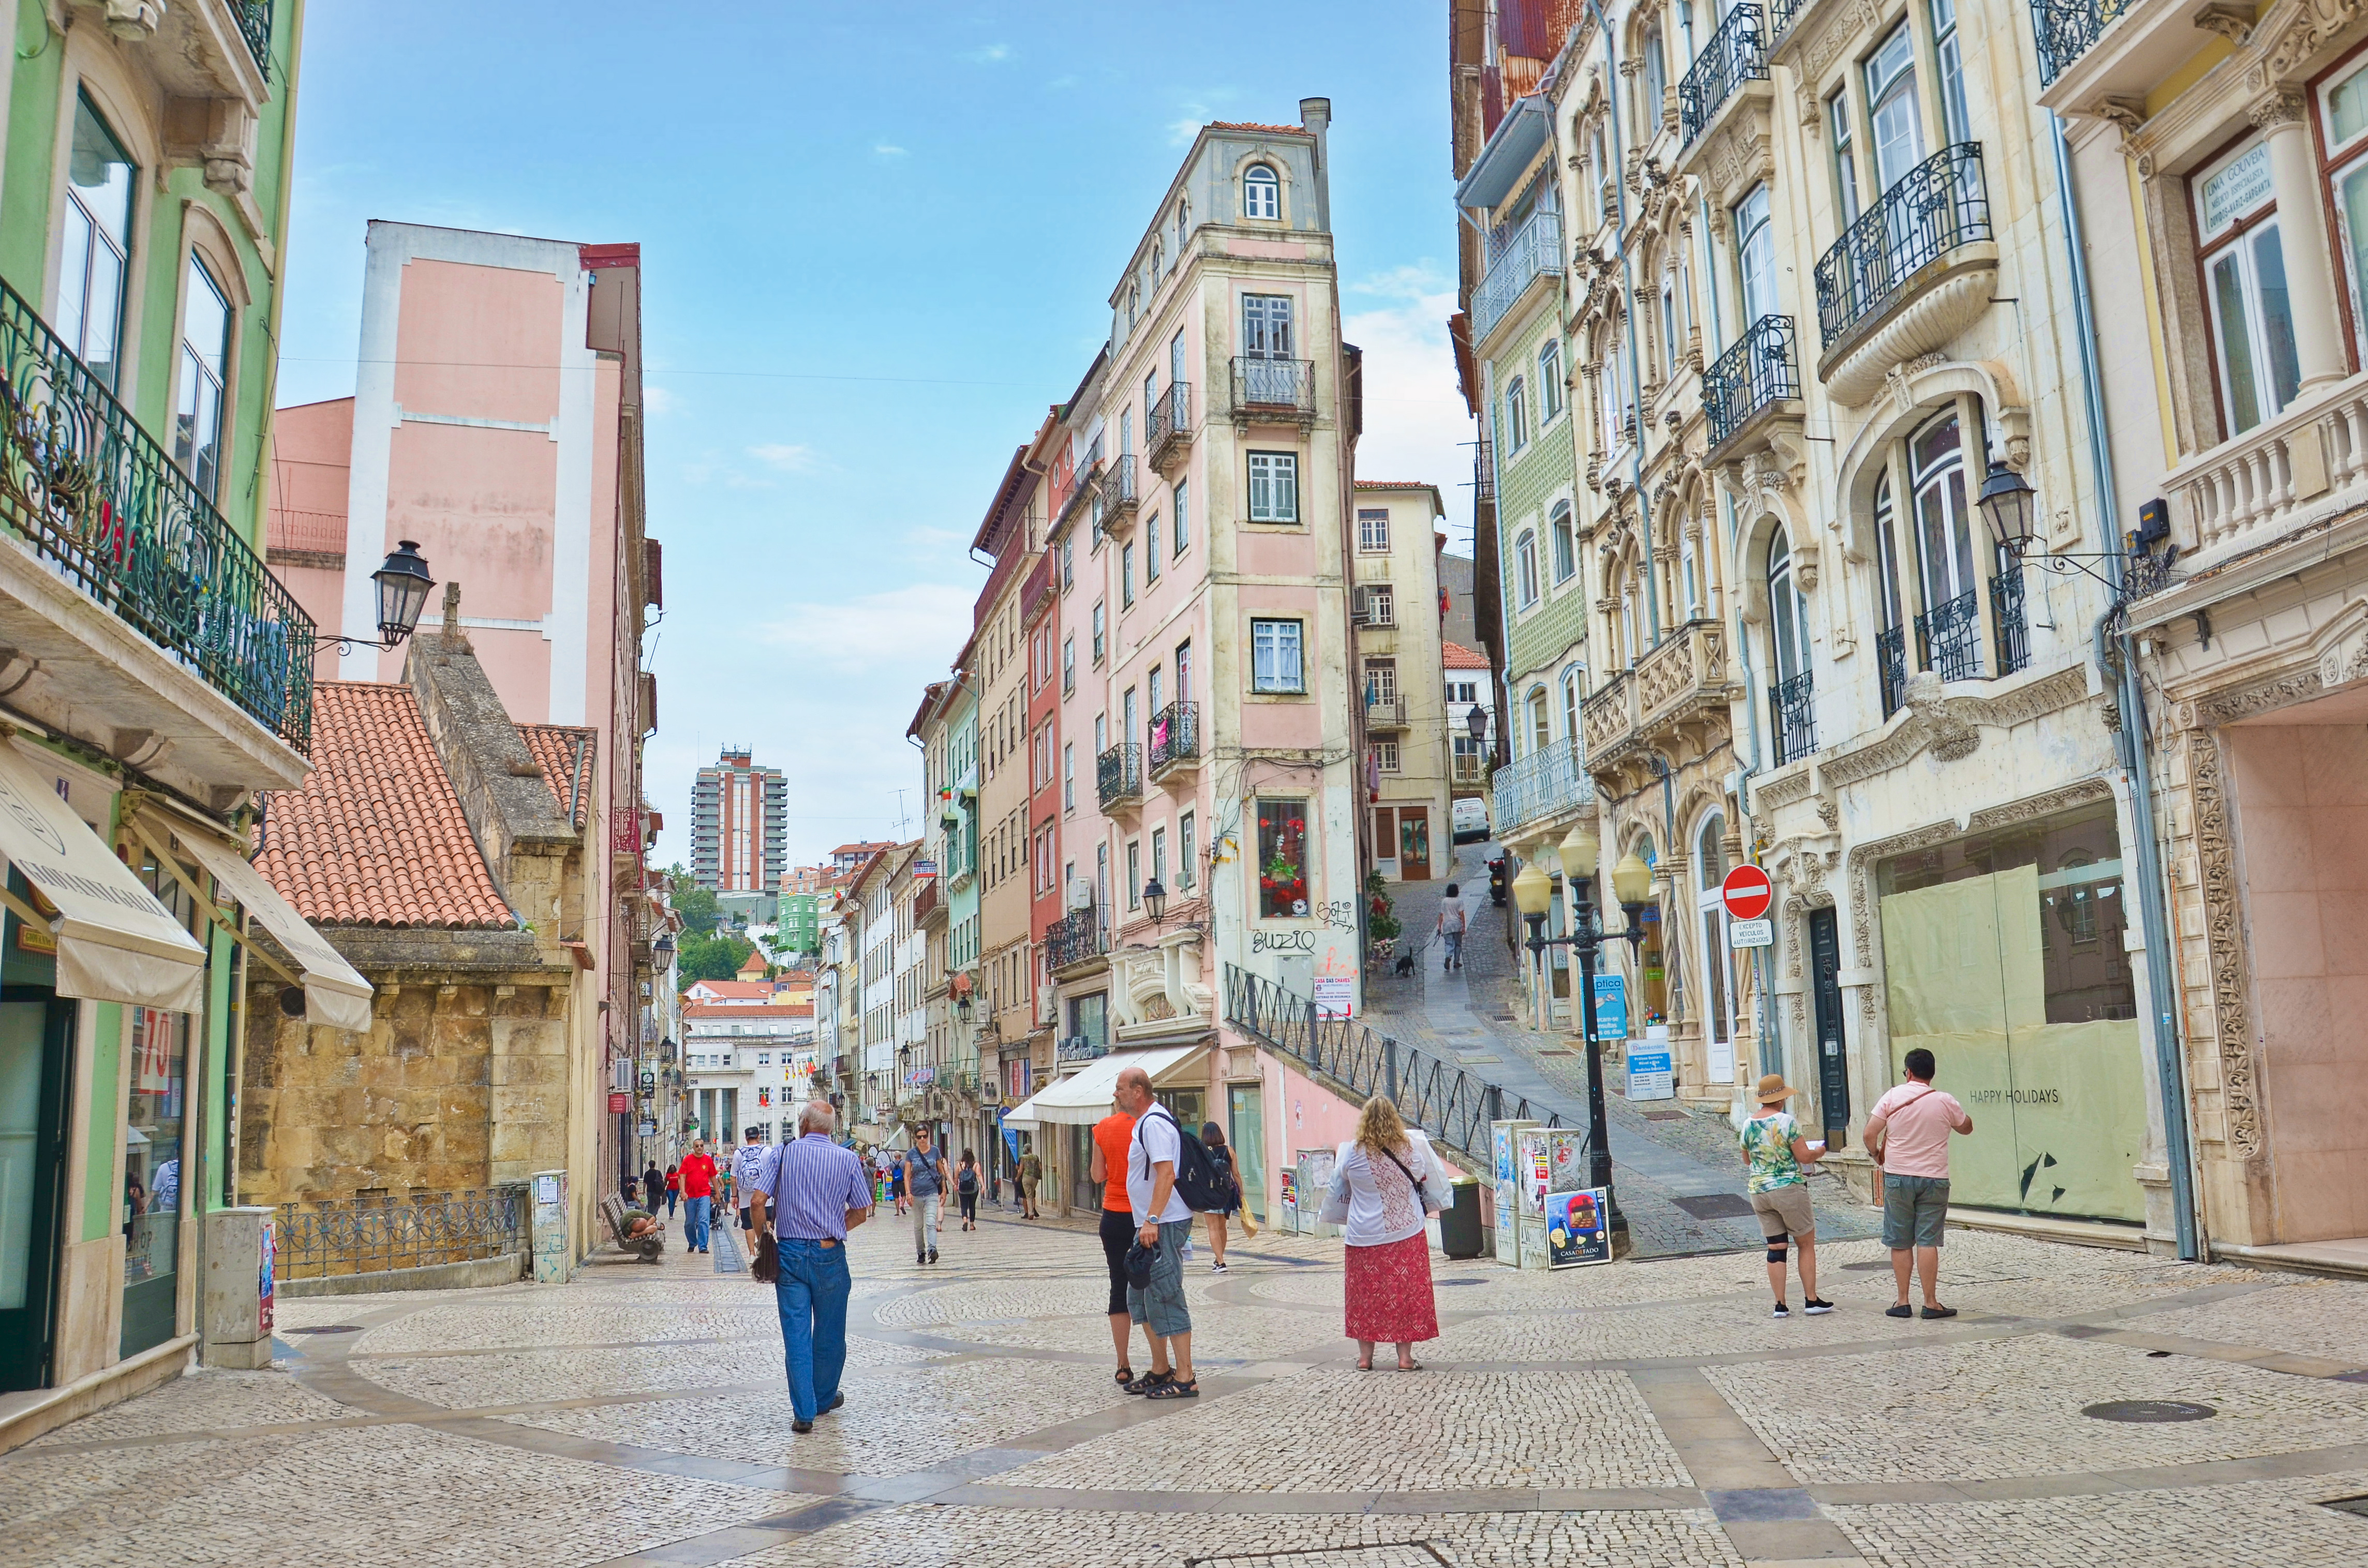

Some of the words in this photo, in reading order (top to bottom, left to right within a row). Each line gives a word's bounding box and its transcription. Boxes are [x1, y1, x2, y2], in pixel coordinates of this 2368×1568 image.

[2208, 176, 2225, 197] LIMA
[2228, 149, 2265, 181] GOUVEIA
[2231, 168, 2265, 196] ESPECIALISTA
[1734, 936, 1769, 945] AUTORIZADOS
[1970, 1090, 2001, 1103] HAPPY
[2005, 1089, 2058, 1103] HOLIDAYS
